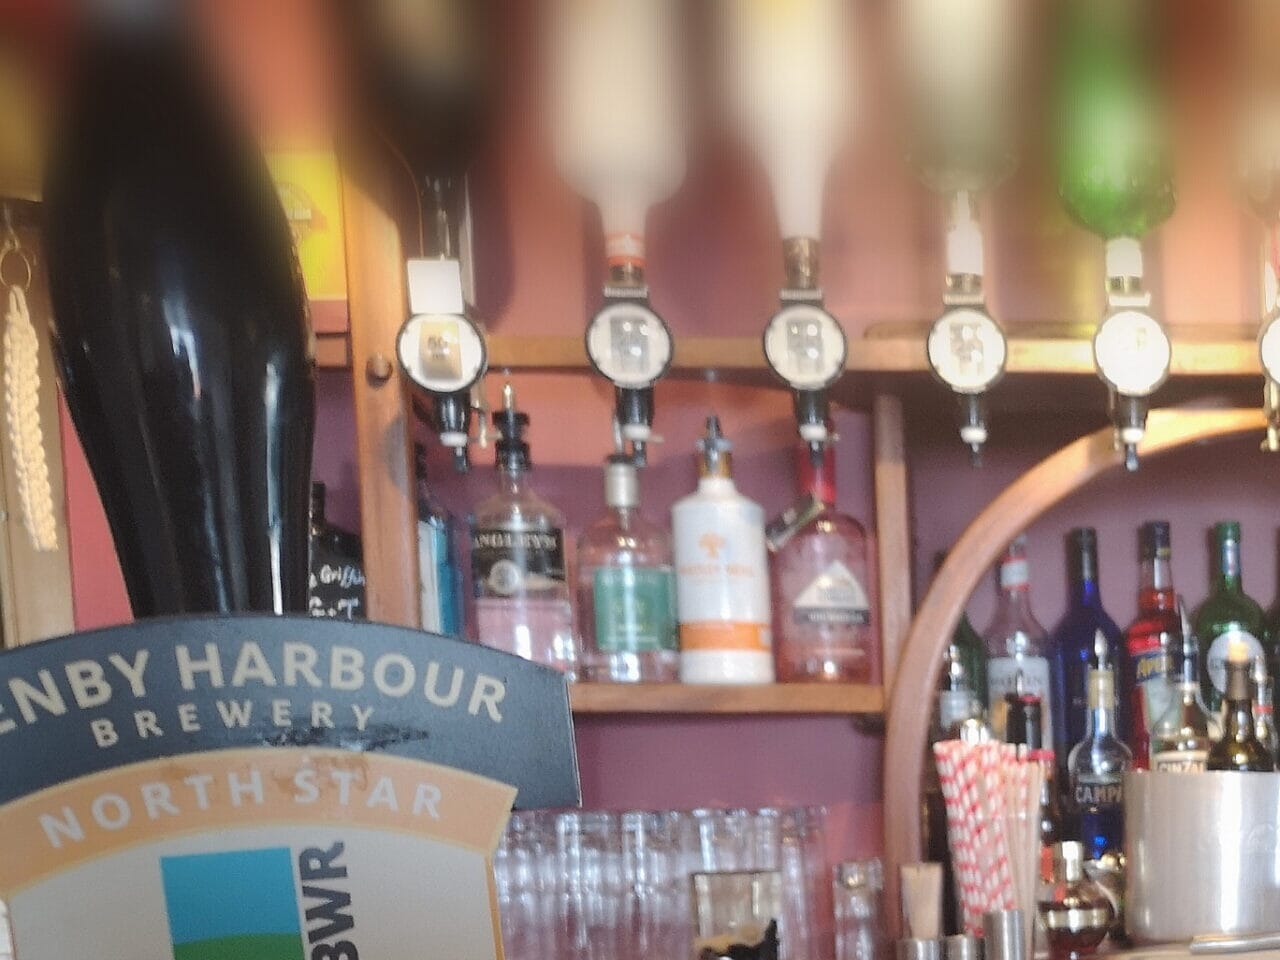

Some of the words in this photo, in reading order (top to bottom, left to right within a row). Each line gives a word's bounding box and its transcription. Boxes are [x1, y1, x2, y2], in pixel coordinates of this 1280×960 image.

[174, 641, 508, 722] HARBOUR
[90, 699, 375, 748] BREWERY
[38, 768, 266, 848] NORTH
[293, 769, 443, 820] STAR
